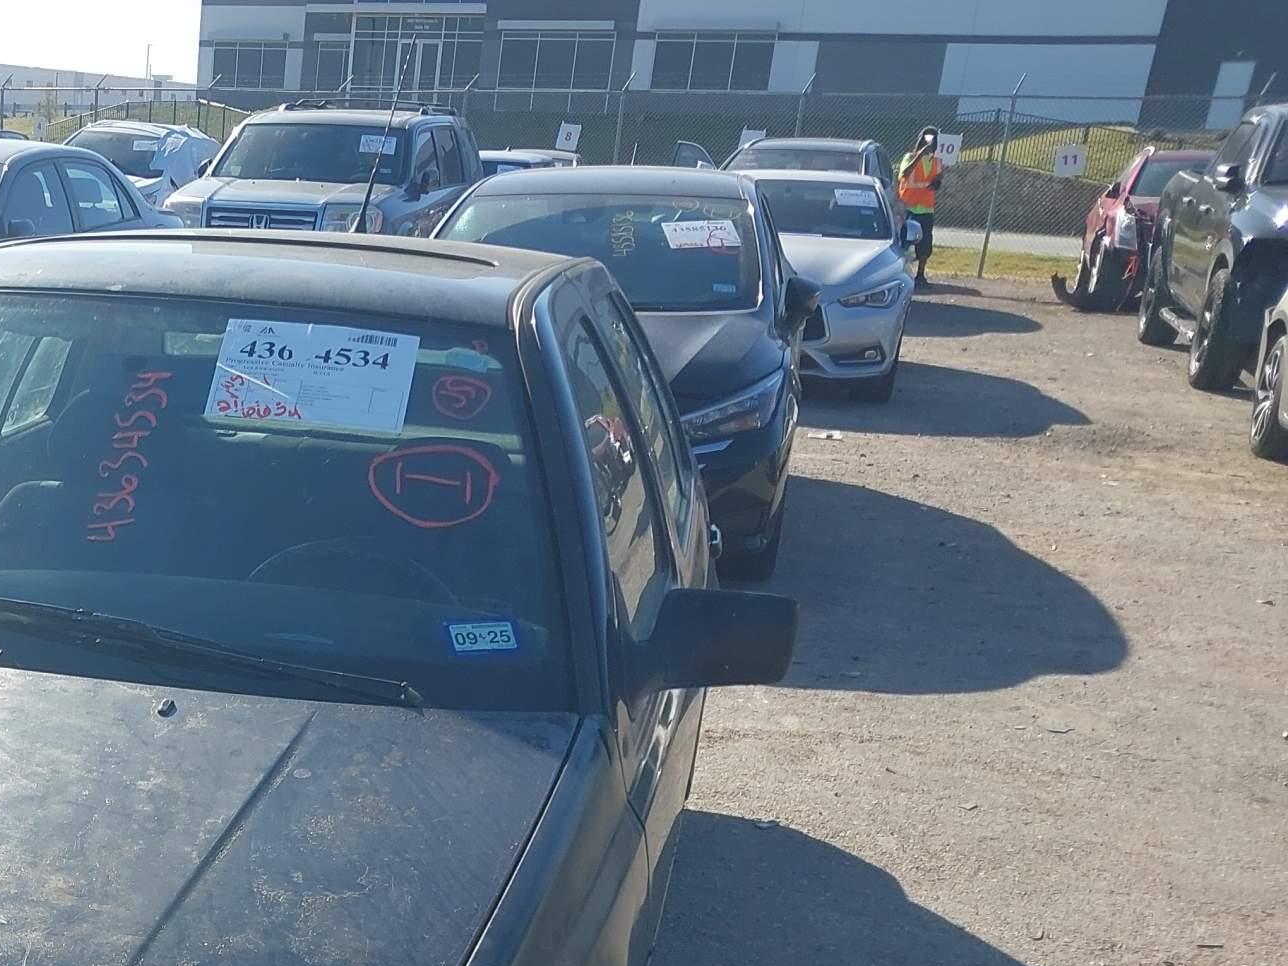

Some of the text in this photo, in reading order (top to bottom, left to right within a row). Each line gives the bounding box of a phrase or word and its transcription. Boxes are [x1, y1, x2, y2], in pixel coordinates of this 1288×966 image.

[564, 131, 572, 142] 8
[939, 143, 955, 154] 10
[1062, 154, 1078, 166] 11
[239, 339, 391, 370] 436 4534
[87, 372, 173, 541] 43634534
[454, 630, 511, 646] 09 25
